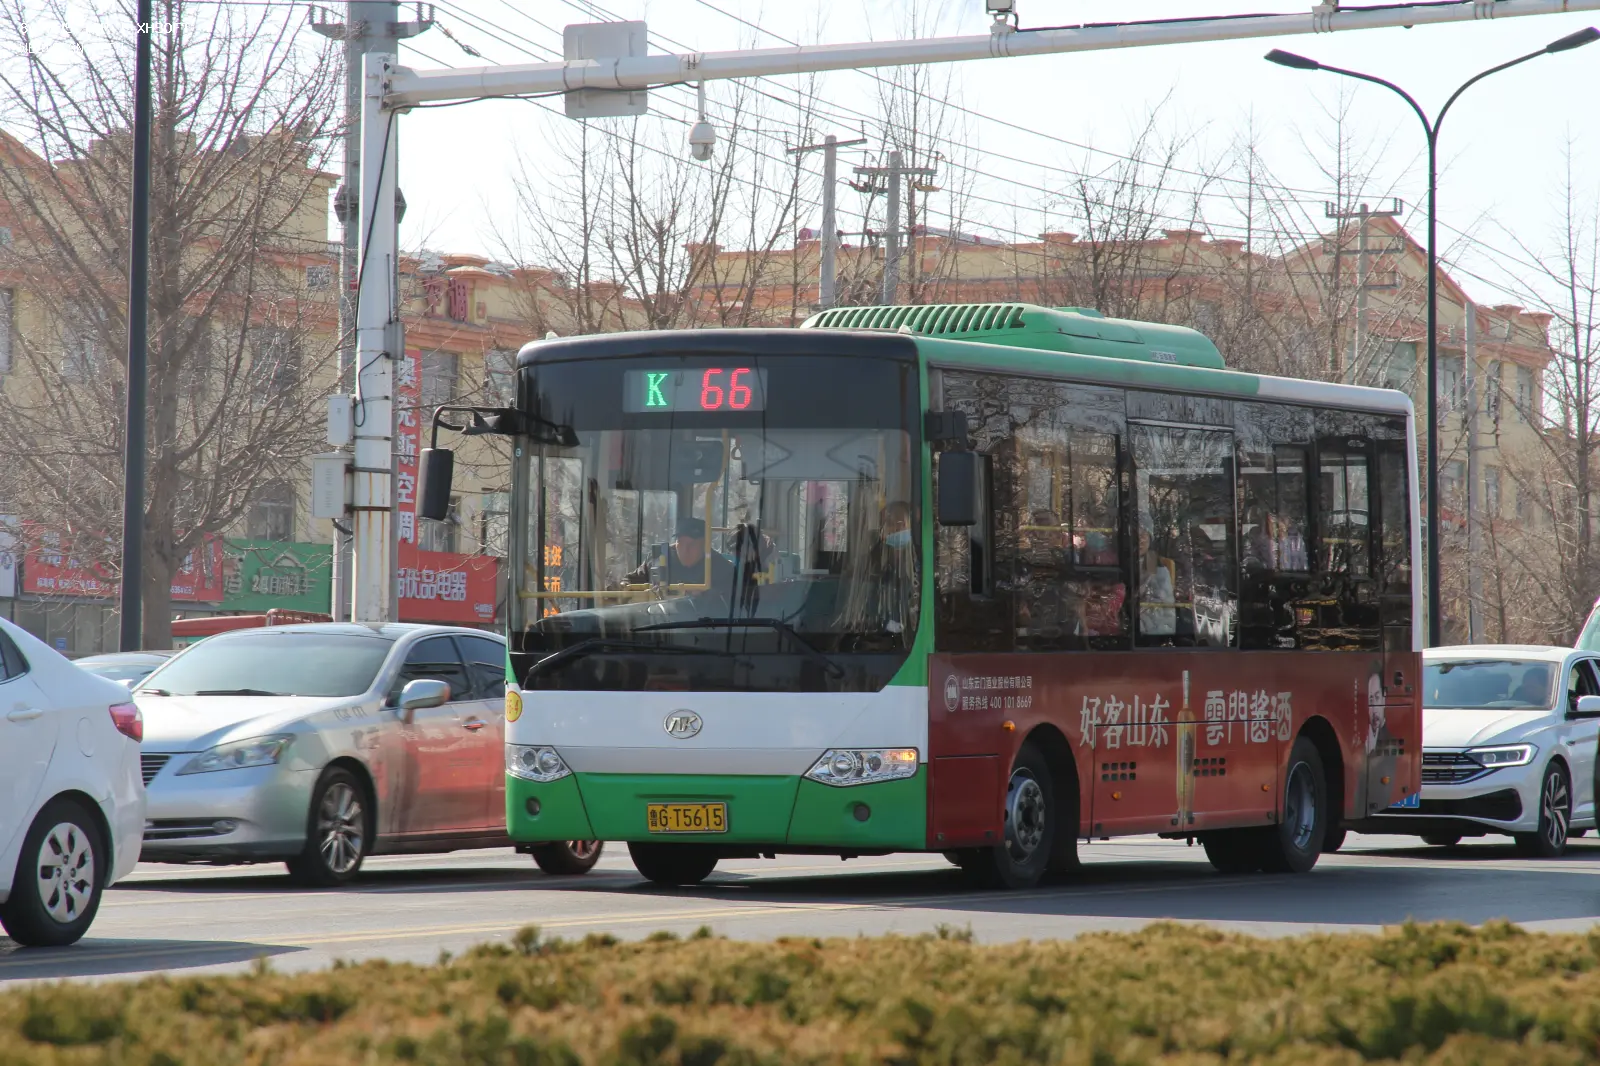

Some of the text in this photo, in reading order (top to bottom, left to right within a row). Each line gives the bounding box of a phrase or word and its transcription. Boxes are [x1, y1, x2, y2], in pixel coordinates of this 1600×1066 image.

[646, 368, 752, 409] K 66
[962, 695, 1032, 711] 服务热线 400 101 8669
[1079, 693, 1170, 750] 好客山东
